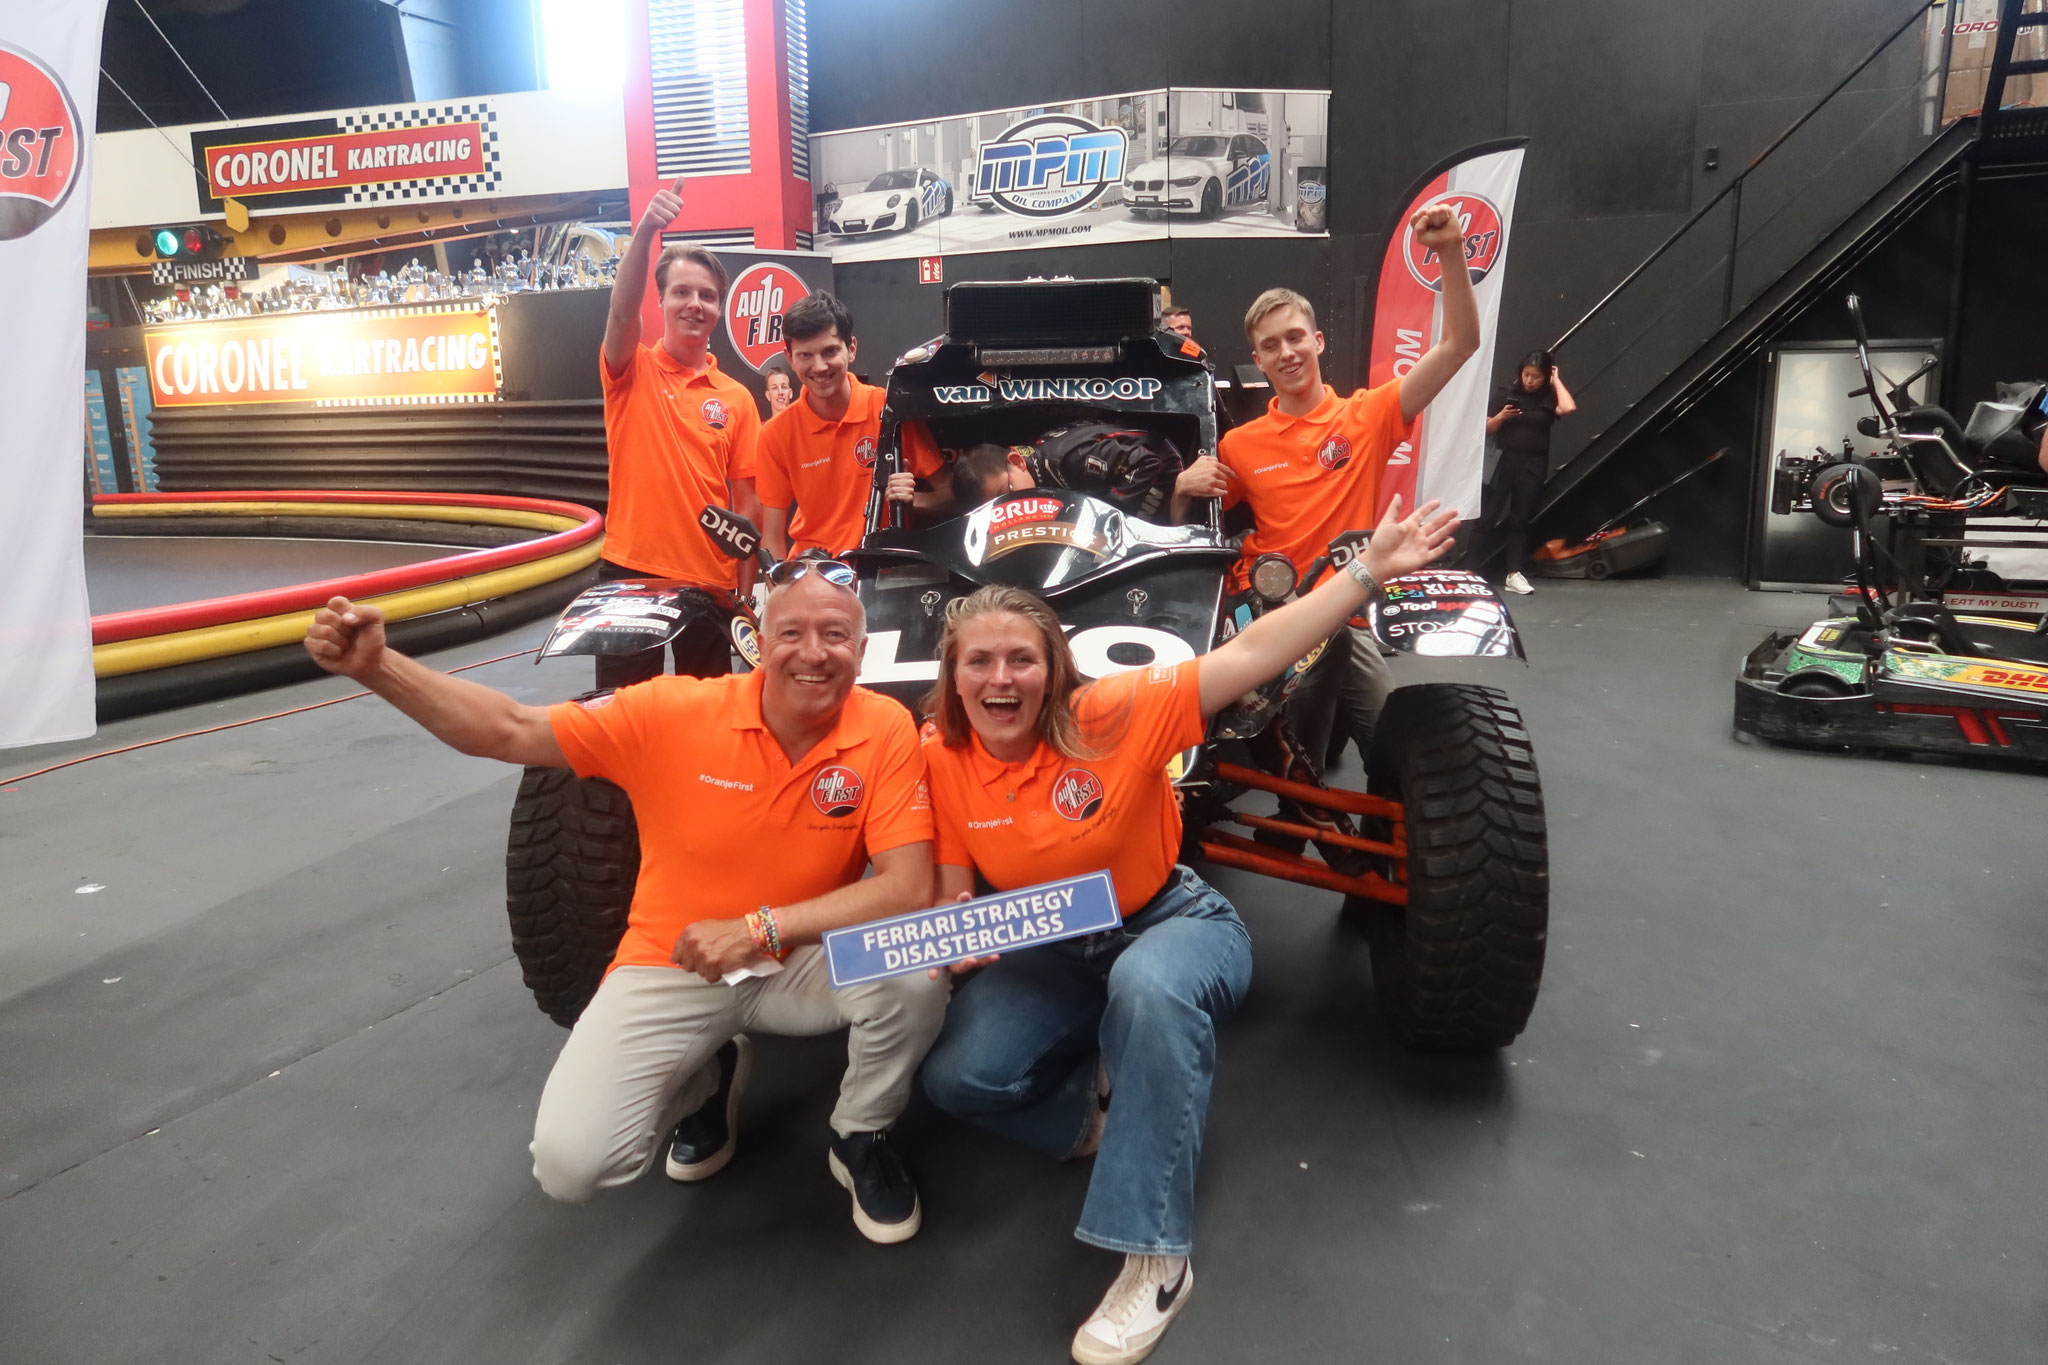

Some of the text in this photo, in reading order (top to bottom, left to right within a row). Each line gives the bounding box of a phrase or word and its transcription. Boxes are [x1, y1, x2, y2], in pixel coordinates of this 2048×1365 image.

[213, 138, 472, 188] CORONEL KARTRACING
[1011, 187, 1084, 209] OIL COMPANY
[1008, 225, 1092, 239] WWW.MPMOIL.COM
[174, 262, 223, 281] FINISH
[155, 332, 487, 395] CORONEL KARTRACING
[933, 377, 1162, 403] van WINKOOP
[993, 515, 1037, 530] HOLLAND
[1330, 536, 1370, 567] DH
[1425, 587, 1493, 596] GUARD
[1950, 598, 2039, 609] EAT MY DUST!
[699, 773, 754, 792] #OranjeFirst
[968, 816, 1014, 830] #OranjeFirst
[863, 887, 1074, 952] FERRARI STRATEGY
[884, 913, 1064, 970] DISASTERCLASS
